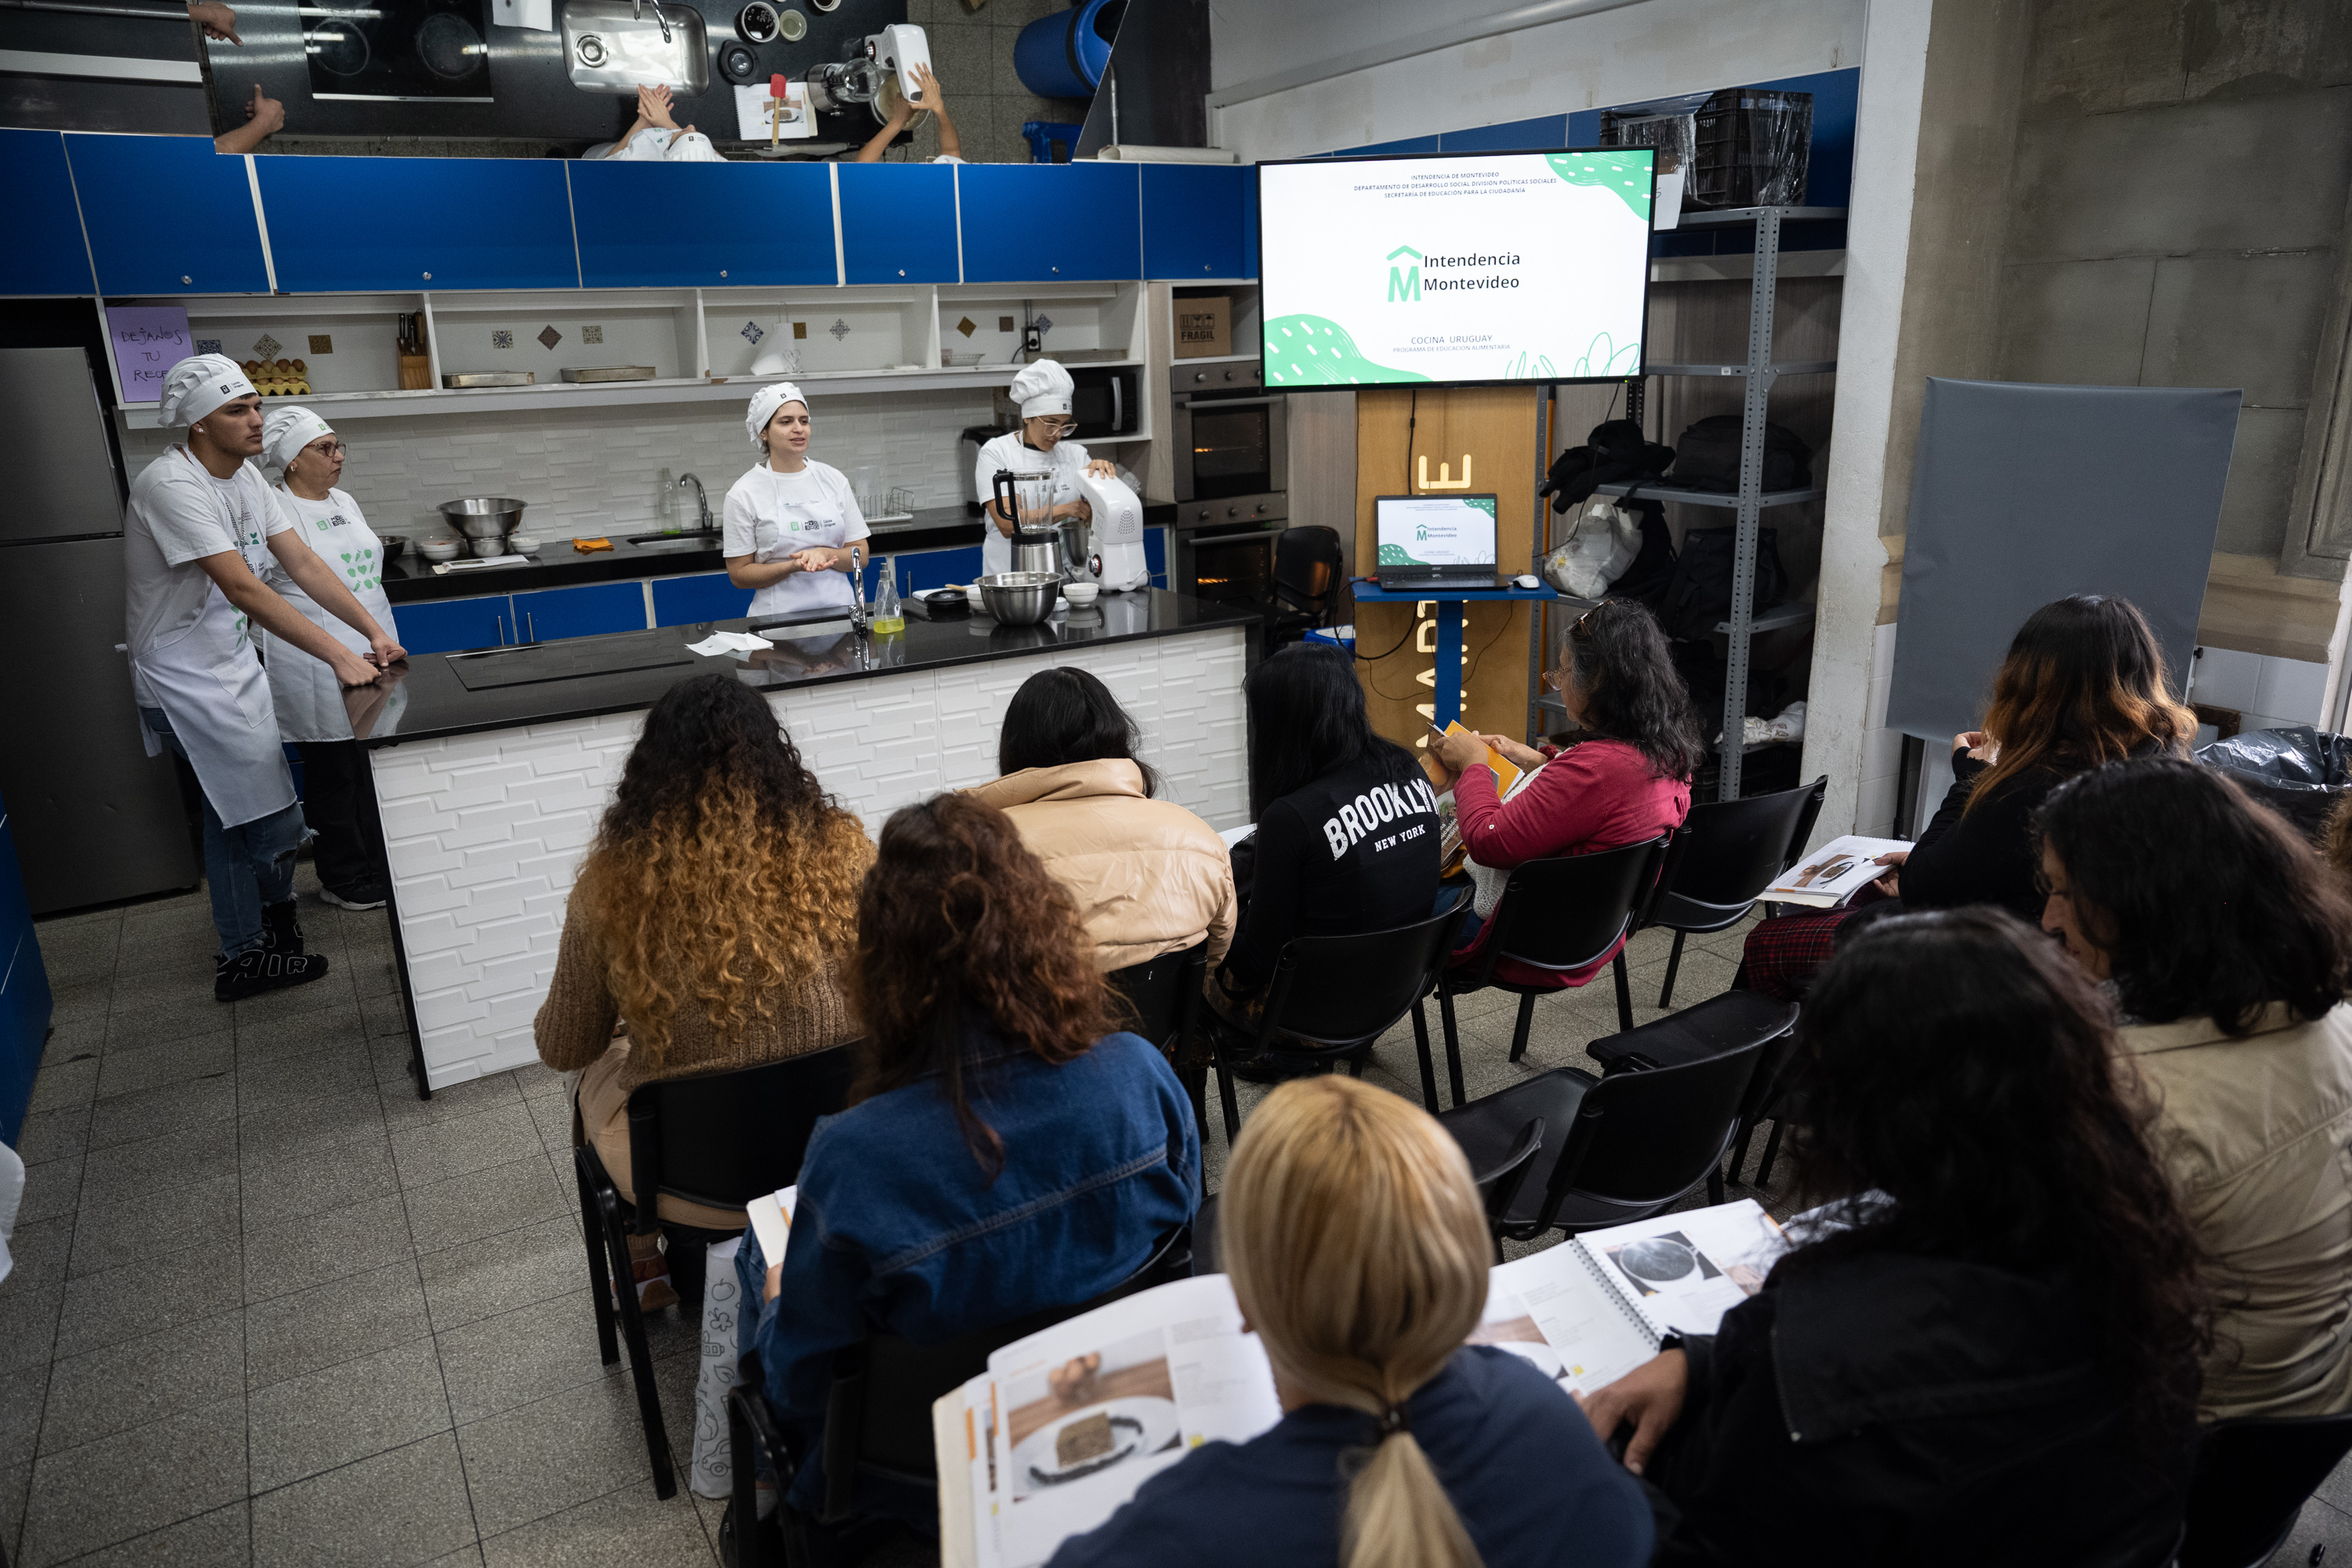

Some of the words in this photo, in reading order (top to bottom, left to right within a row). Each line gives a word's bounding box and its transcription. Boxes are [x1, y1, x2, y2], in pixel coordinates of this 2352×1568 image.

[1384, 190, 1418, 198] SECRETARÍA
[1428, 188, 1463, 197] EDUCACIÓN
[1425, 252, 1521, 268] Intendencia
[1424, 275, 1520, 291] Montevideo
[1181, 330, 1214, 340] FRAGIL
[1410, 336, 1445, 345] COCINA
[1450, 335, 1493, 343] URUGUAY
[141, 350, 161, 362] TU
[1323, 778, 1441, 862] BROOKLYN
[1374, 835, 1397, 852] NEW
[1399, 824, 1426, 842] YORK
[1441, 826, 1460, 848] mentaria
[233, 949, 308, 982] AIR
